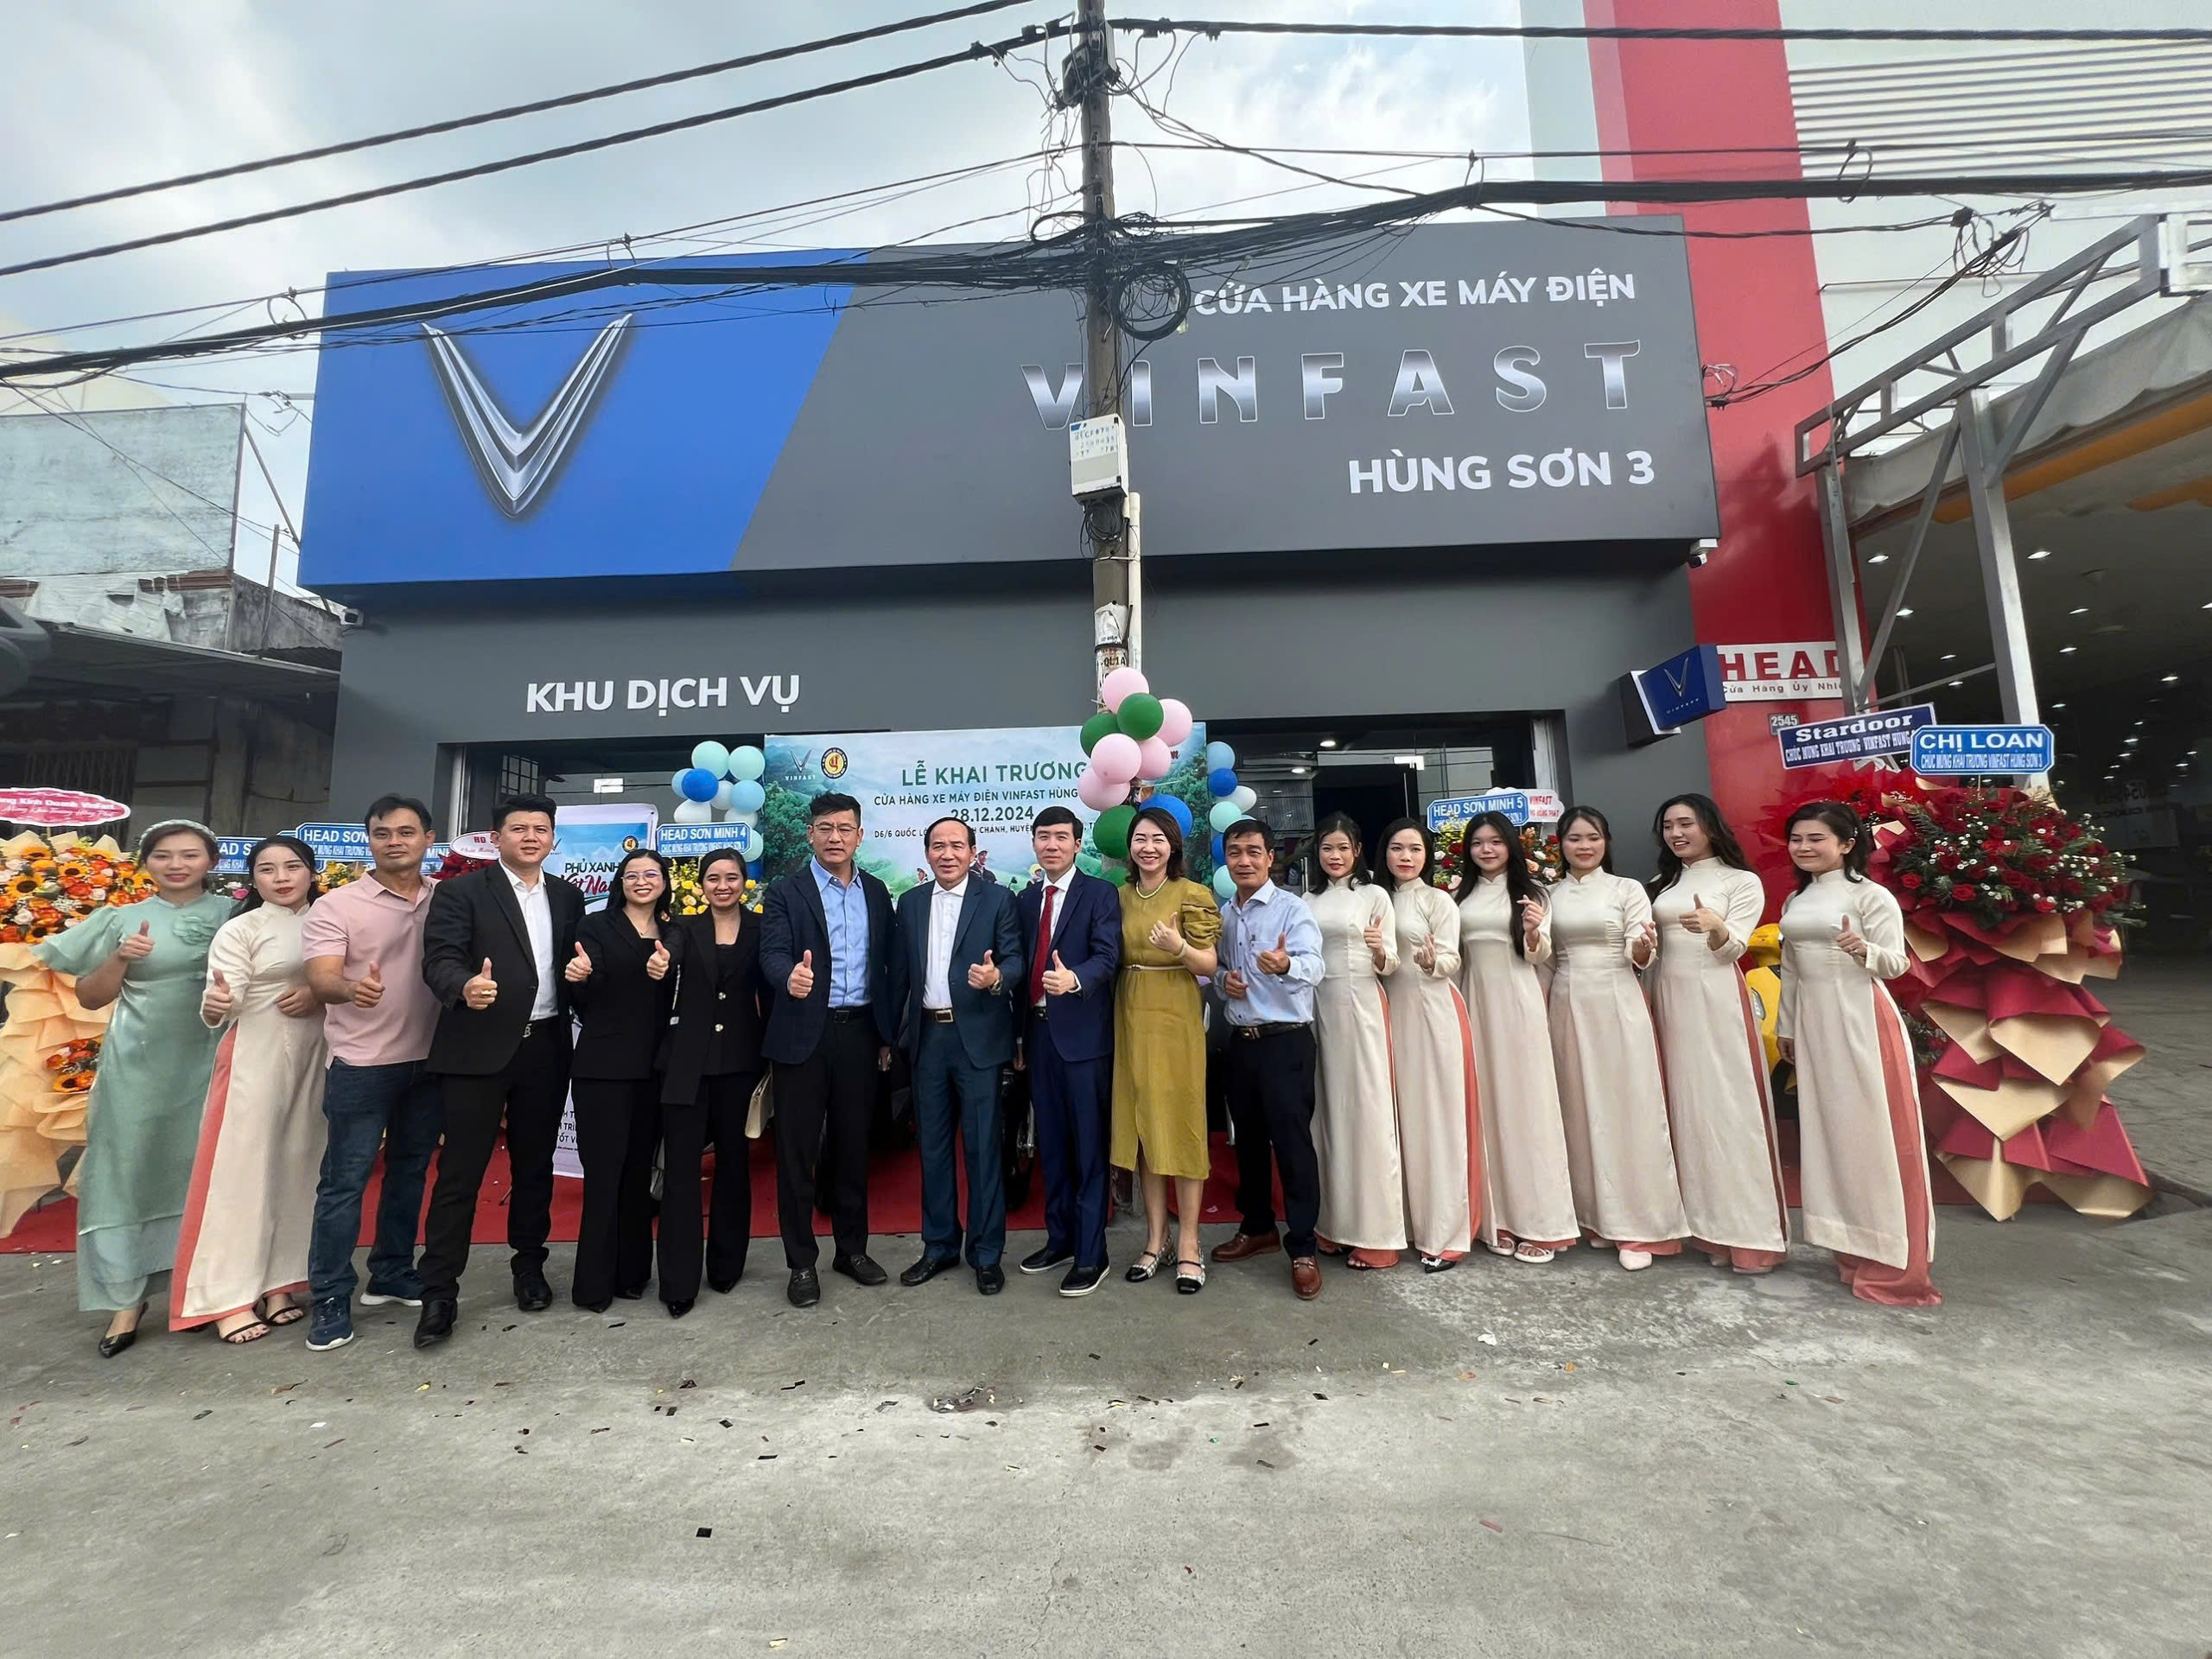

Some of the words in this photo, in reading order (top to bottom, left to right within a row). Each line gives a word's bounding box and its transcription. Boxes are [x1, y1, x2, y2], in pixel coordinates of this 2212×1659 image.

[1195, 282, 1272, 315] CỬA
[1282, 278, 1389, 311] HÀNG
[1400, 281, 1447, 307] XE
[1459, 271, 1536, 304] MÁY
[1546, 268, 1636, 307] ĐIỆN
[1020, 340, 1640, 429] VINFAST
[1349, 448, 1491, 493] HÙNG
[1508, 448, 1611, 489] SƠN
[1627, 450, 1654, 486] 3
[526, 680, 614, 713] KHU
[627, 677, 728, 717] DỊCH
[739, 675, 800, 713] VỤ
[1770, 715, 1798, 726] 2545
[1796, 714, 1913, 743] Stardoor
[1919, 734, 1962, 752] CHỊ
[1971, 733, 2044, 749] LOAN
[902, 760, 926, 786] LỄ
[936, 766, 987, 785] KHAI
[995, 761, 1087, 782] TRƯƠNG
[874, 792, 896, 805] CỬA
[899, 791, 929, 804] HÀNG
[933, 793, 945, 804] XE
[950, 791, 970, 803] MÁY
[974, 790, 998, 804] ĐIỆN
[1002, 789, 1046, 801] VINFAST
[1049, 786, 1078, 798] HÙNG
[950, 805, 1034, 823] 28.12.2024
[1433, 804, 1460, 817] HEAD
[1464, 801, 1485, 813] SƠN
[1488, 798, 1515, 810] MINH
[1516, 797, 1522, 809] 5
[304, 829, 340, 842] HEAD
[342, 830, 369, 843] SƠN
[660, 829, 688, 841] HEAD
[690, 828, 711, 839] SƠN
[714, 827, 738, 838] MINH
[740, 827, 746, 837] 4
[895, 827, 916, 837] QUỐC
[219, 842, 239, 855] AD
[564, 858, 587, 873] PHỦ
[585, 874, 610, 895] Na
